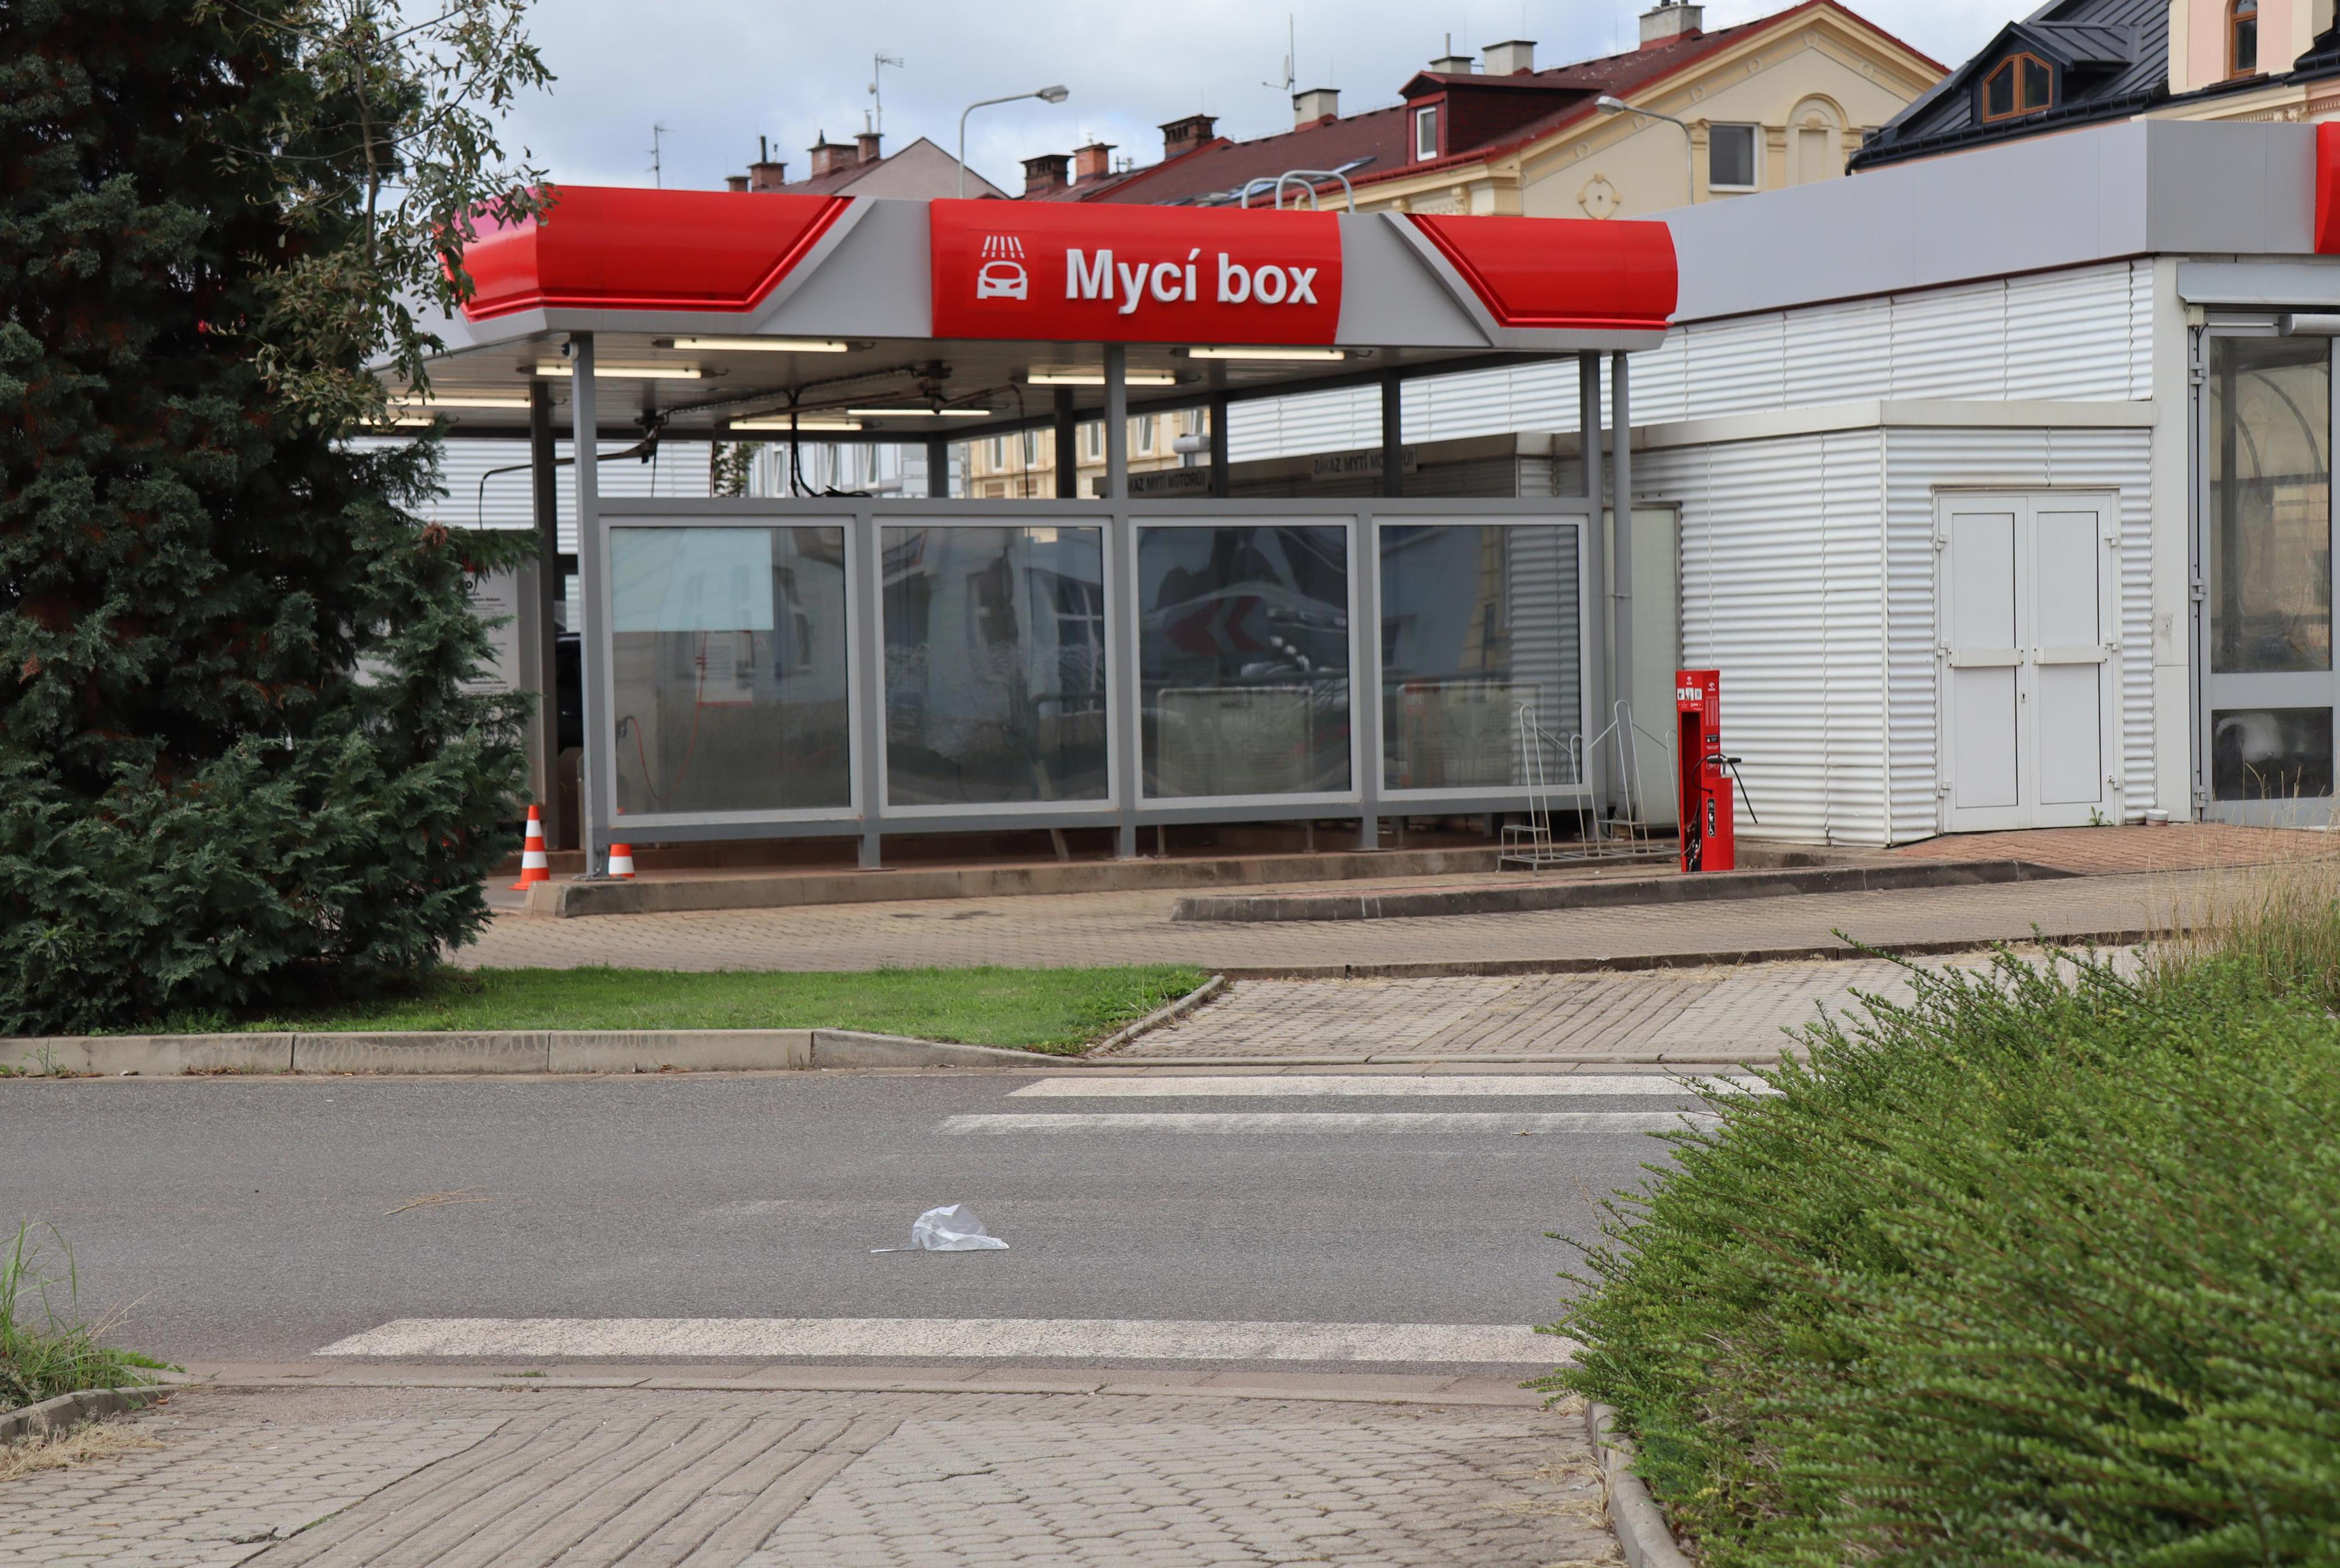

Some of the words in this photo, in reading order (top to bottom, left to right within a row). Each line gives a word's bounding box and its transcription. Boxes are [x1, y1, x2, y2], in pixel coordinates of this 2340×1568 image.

[1066, 248, 1201, 315] Mycí
[1217, 253, 1319, 305] box
[1128, 477, 1144, 492] KAZ
